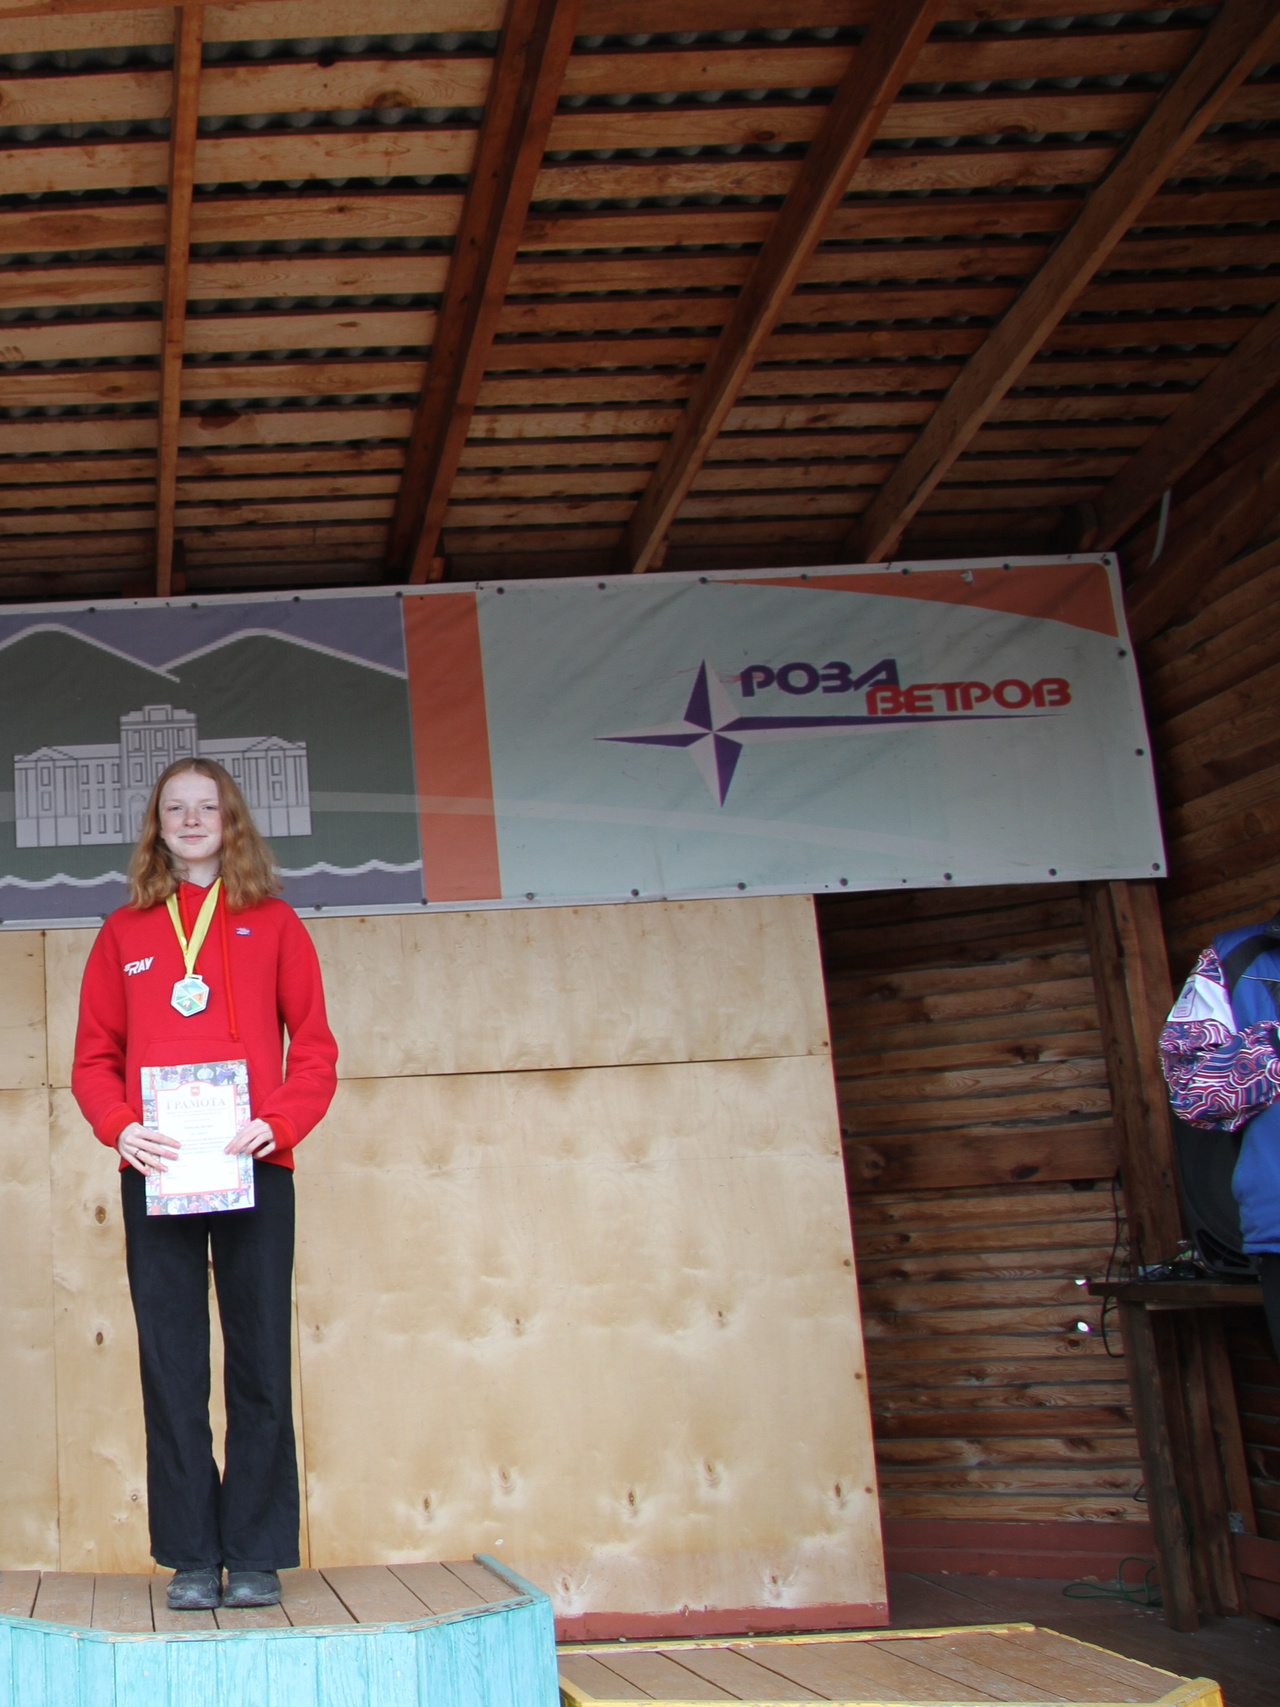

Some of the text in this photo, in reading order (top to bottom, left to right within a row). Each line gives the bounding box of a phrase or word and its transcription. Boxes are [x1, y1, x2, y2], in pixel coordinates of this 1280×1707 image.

[740, 658, 900, 697] РОЗА
[865, 677, 1072, 715] ВЕТРОВ
[166, 1098, 226, 1110] ГРАМОТА
